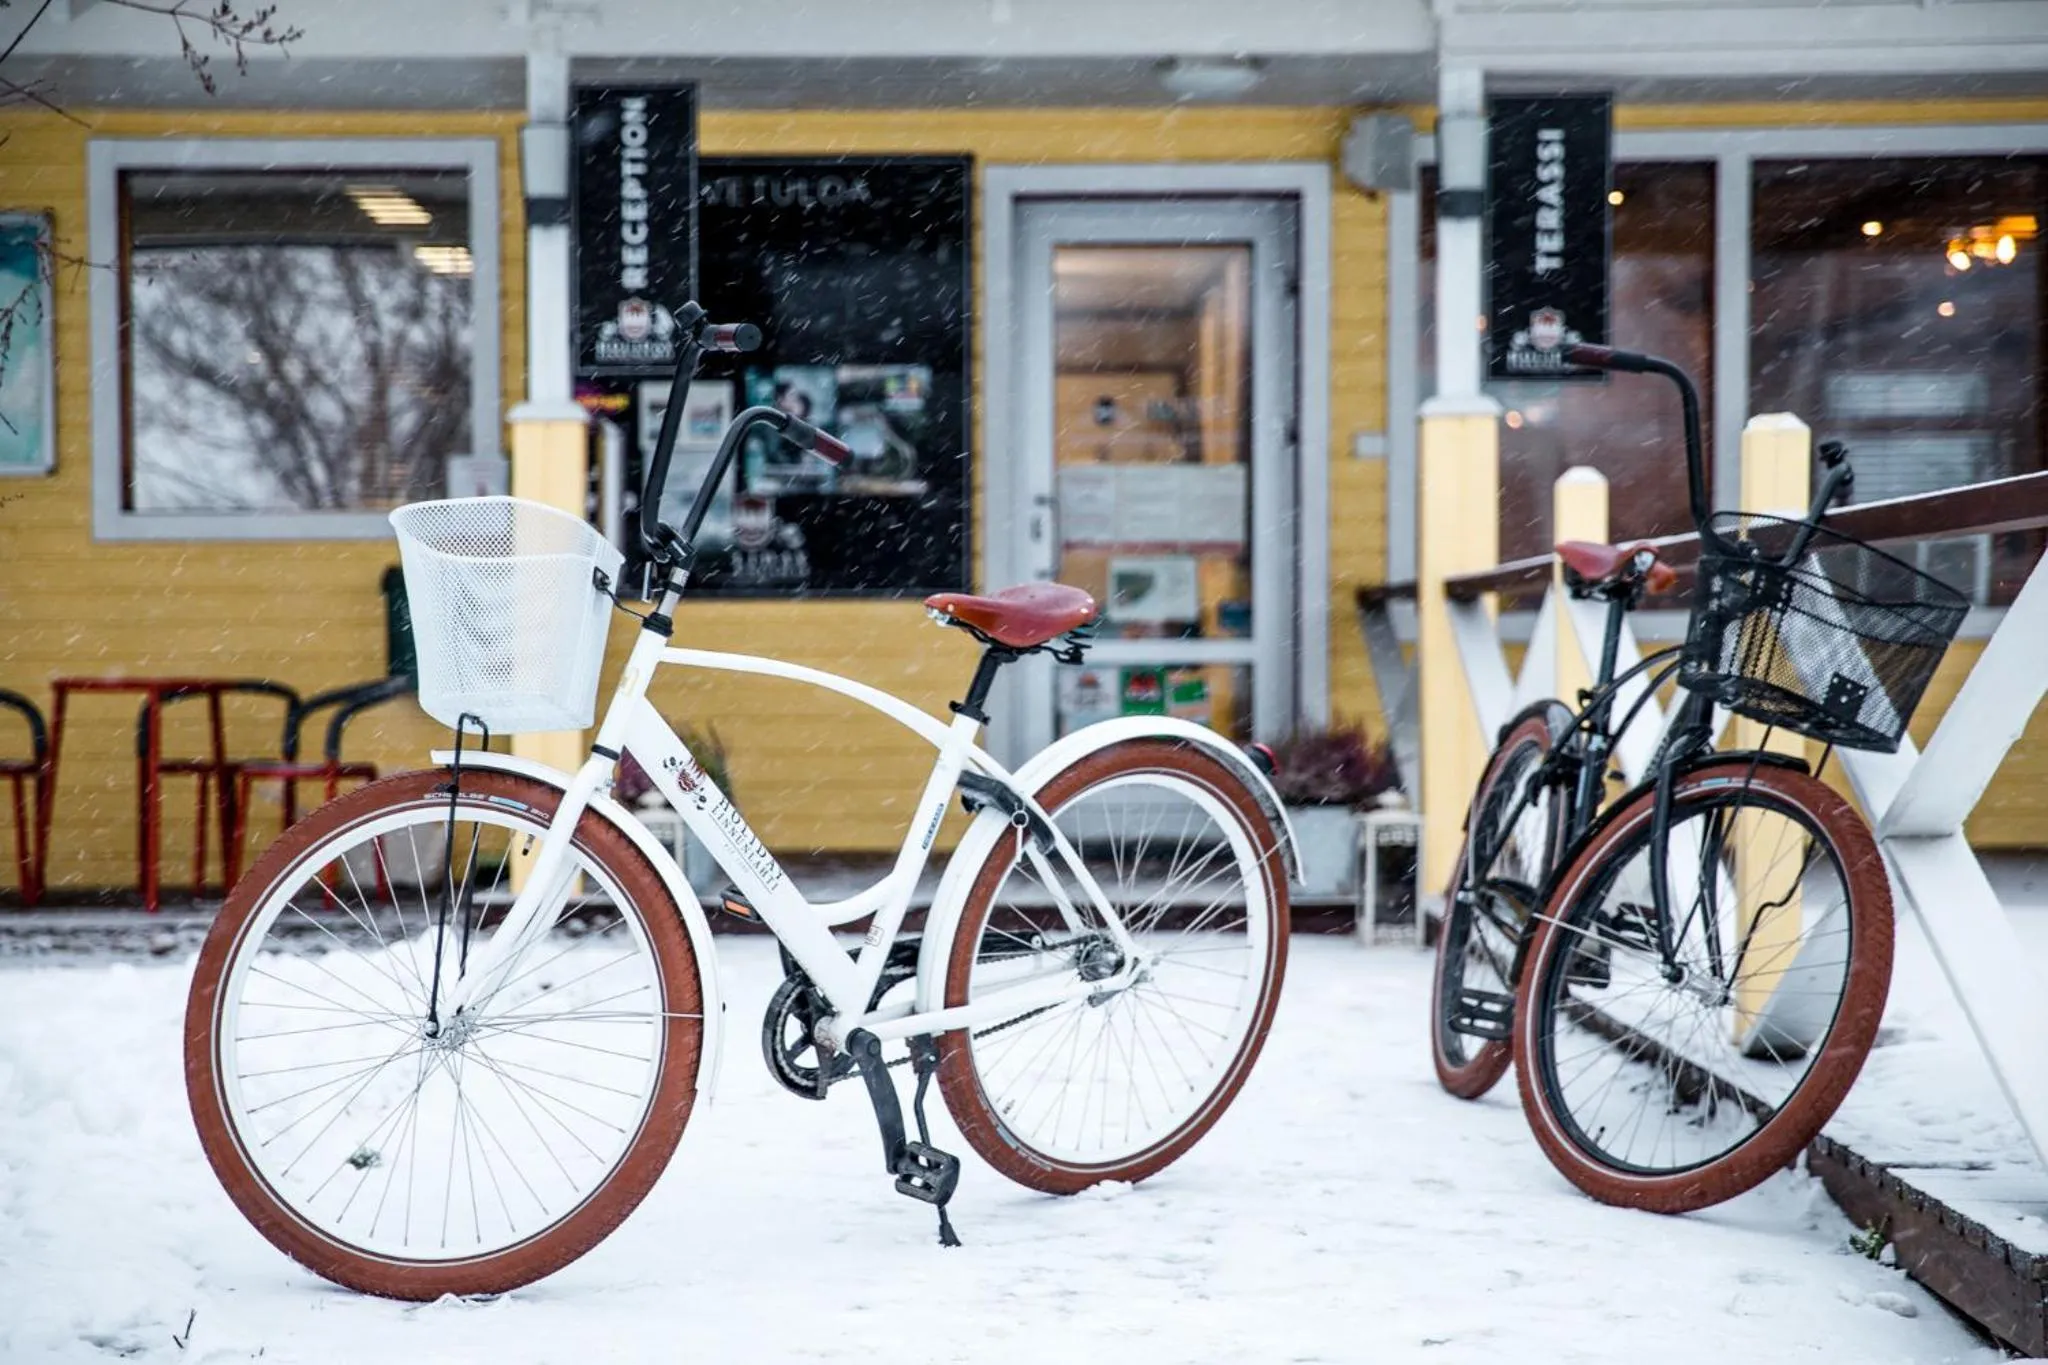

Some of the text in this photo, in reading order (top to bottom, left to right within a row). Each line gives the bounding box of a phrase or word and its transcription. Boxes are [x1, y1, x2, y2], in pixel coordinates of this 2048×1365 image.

[621, 97, 648, 289] RECEPTION
[1535, 129, 1565, 275] TERASSI
[712, 805, 779, 891] LINNUNLAHTI
